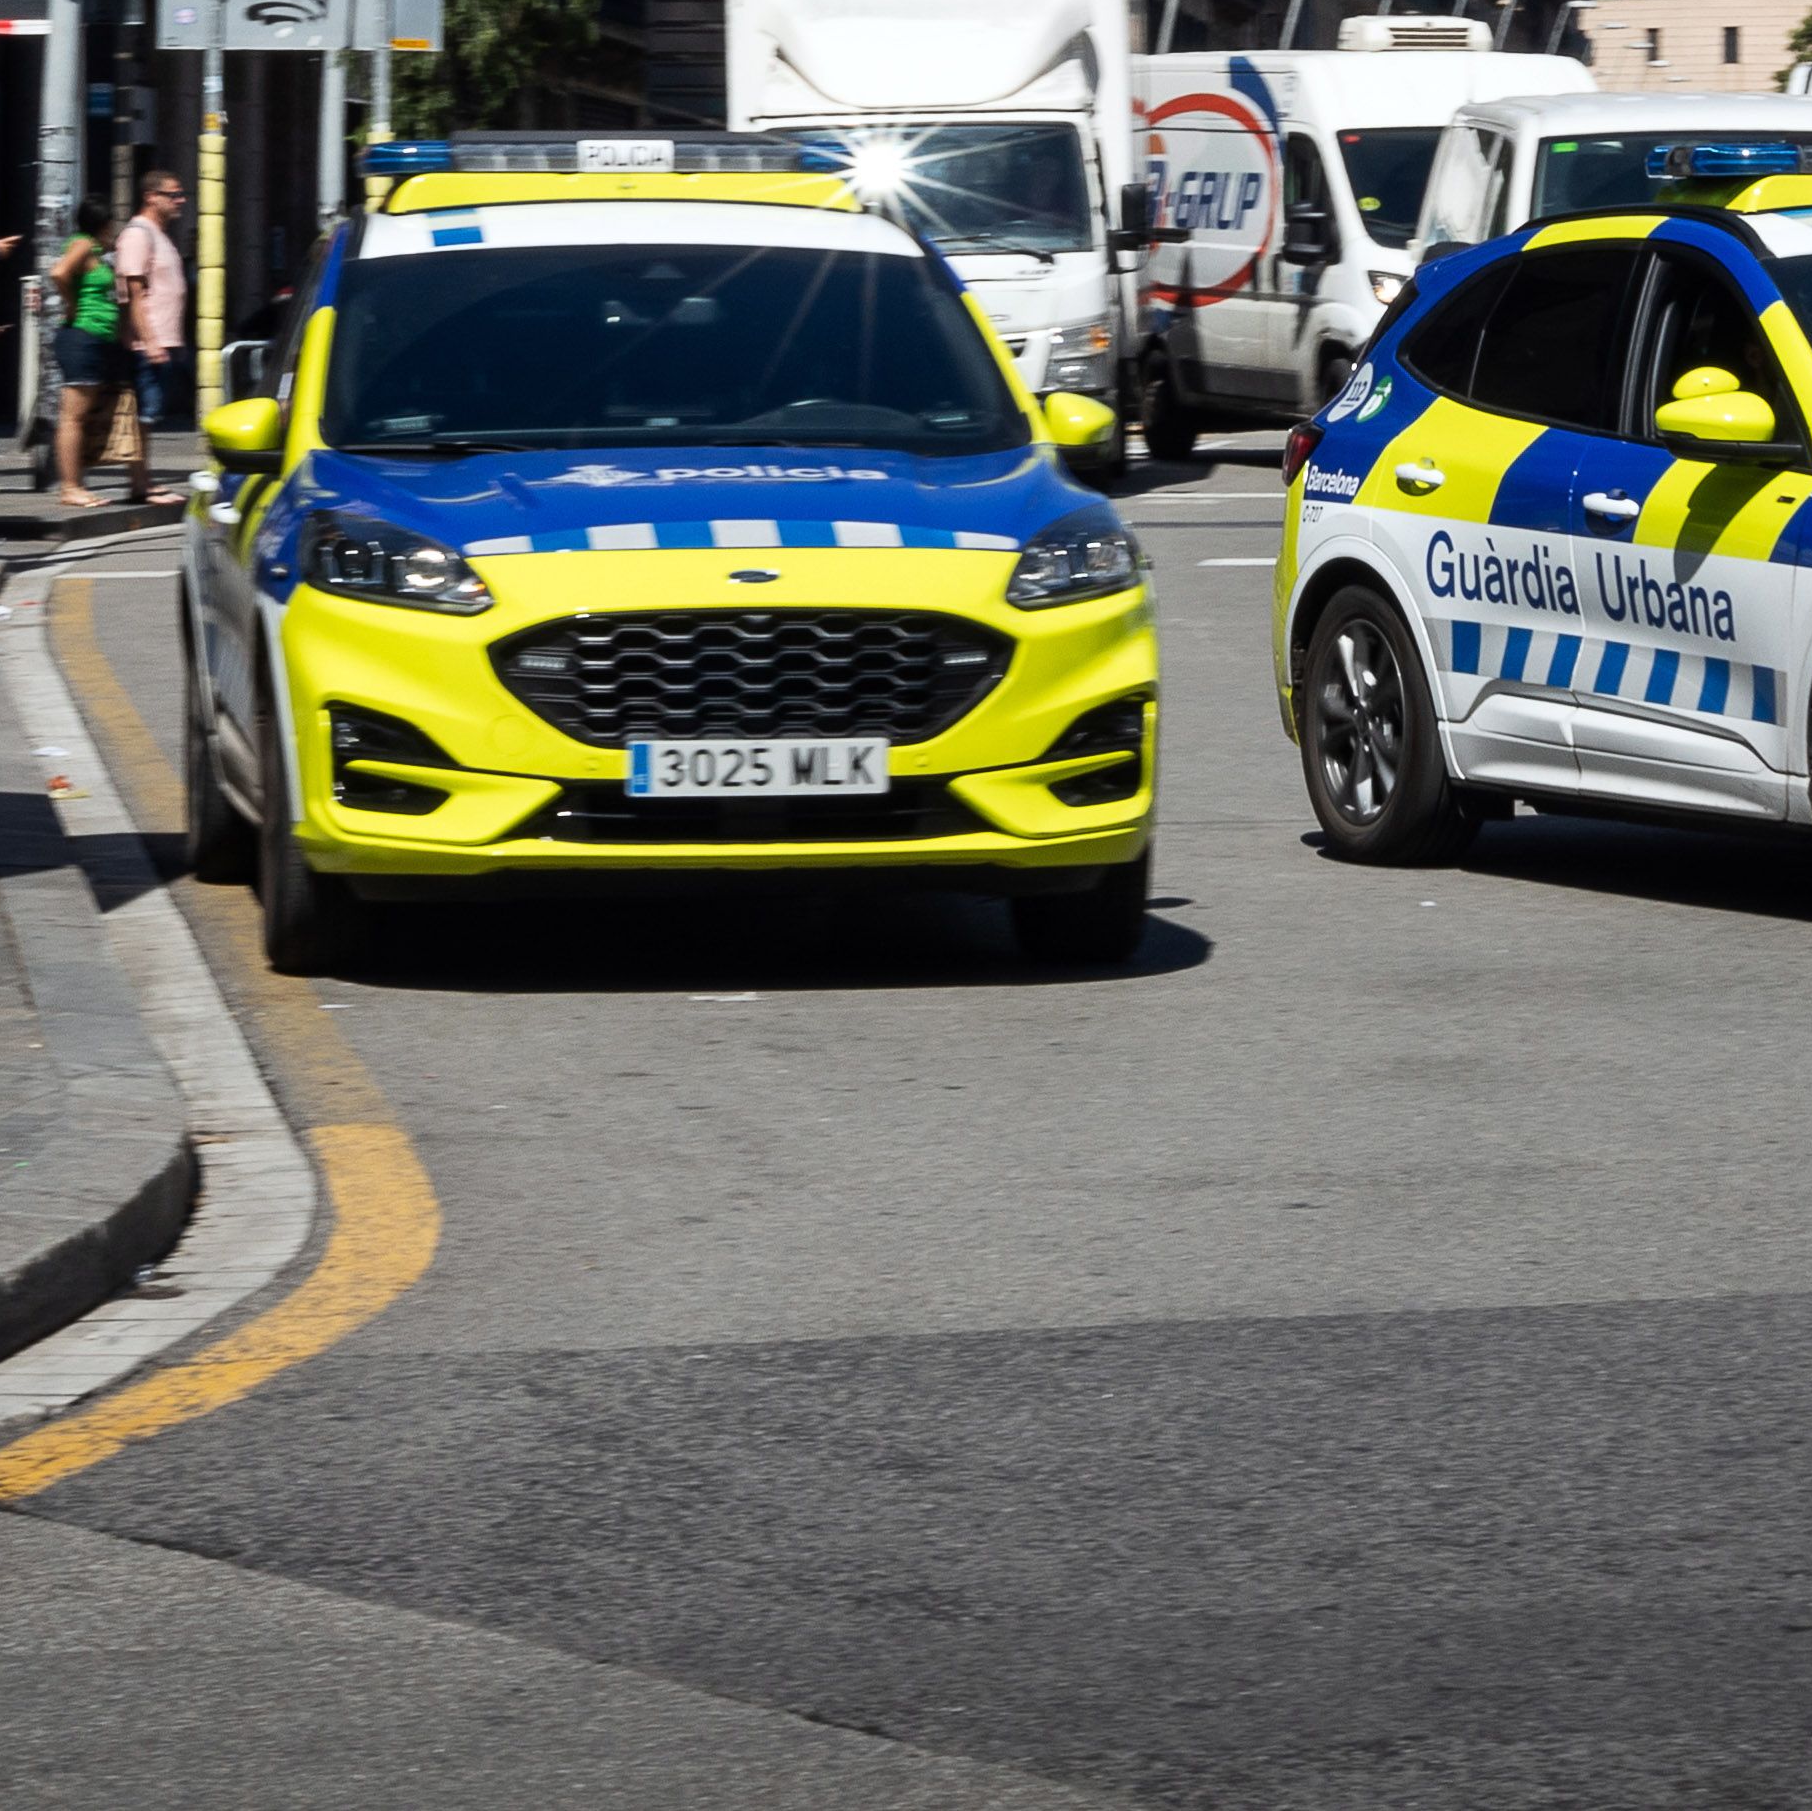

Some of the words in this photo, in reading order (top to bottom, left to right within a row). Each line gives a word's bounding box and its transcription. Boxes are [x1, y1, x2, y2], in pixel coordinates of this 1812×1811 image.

[655, 464, 889, 483] policia
[1307, 464, 1361, 496] Barcelona
[1425, 529, 1581, 616] Guàrdia
[1595, 550, 1737, 642] Urbana
[659, 748, 774, 787] 3025
[789, 745, 877, 786] MLK
